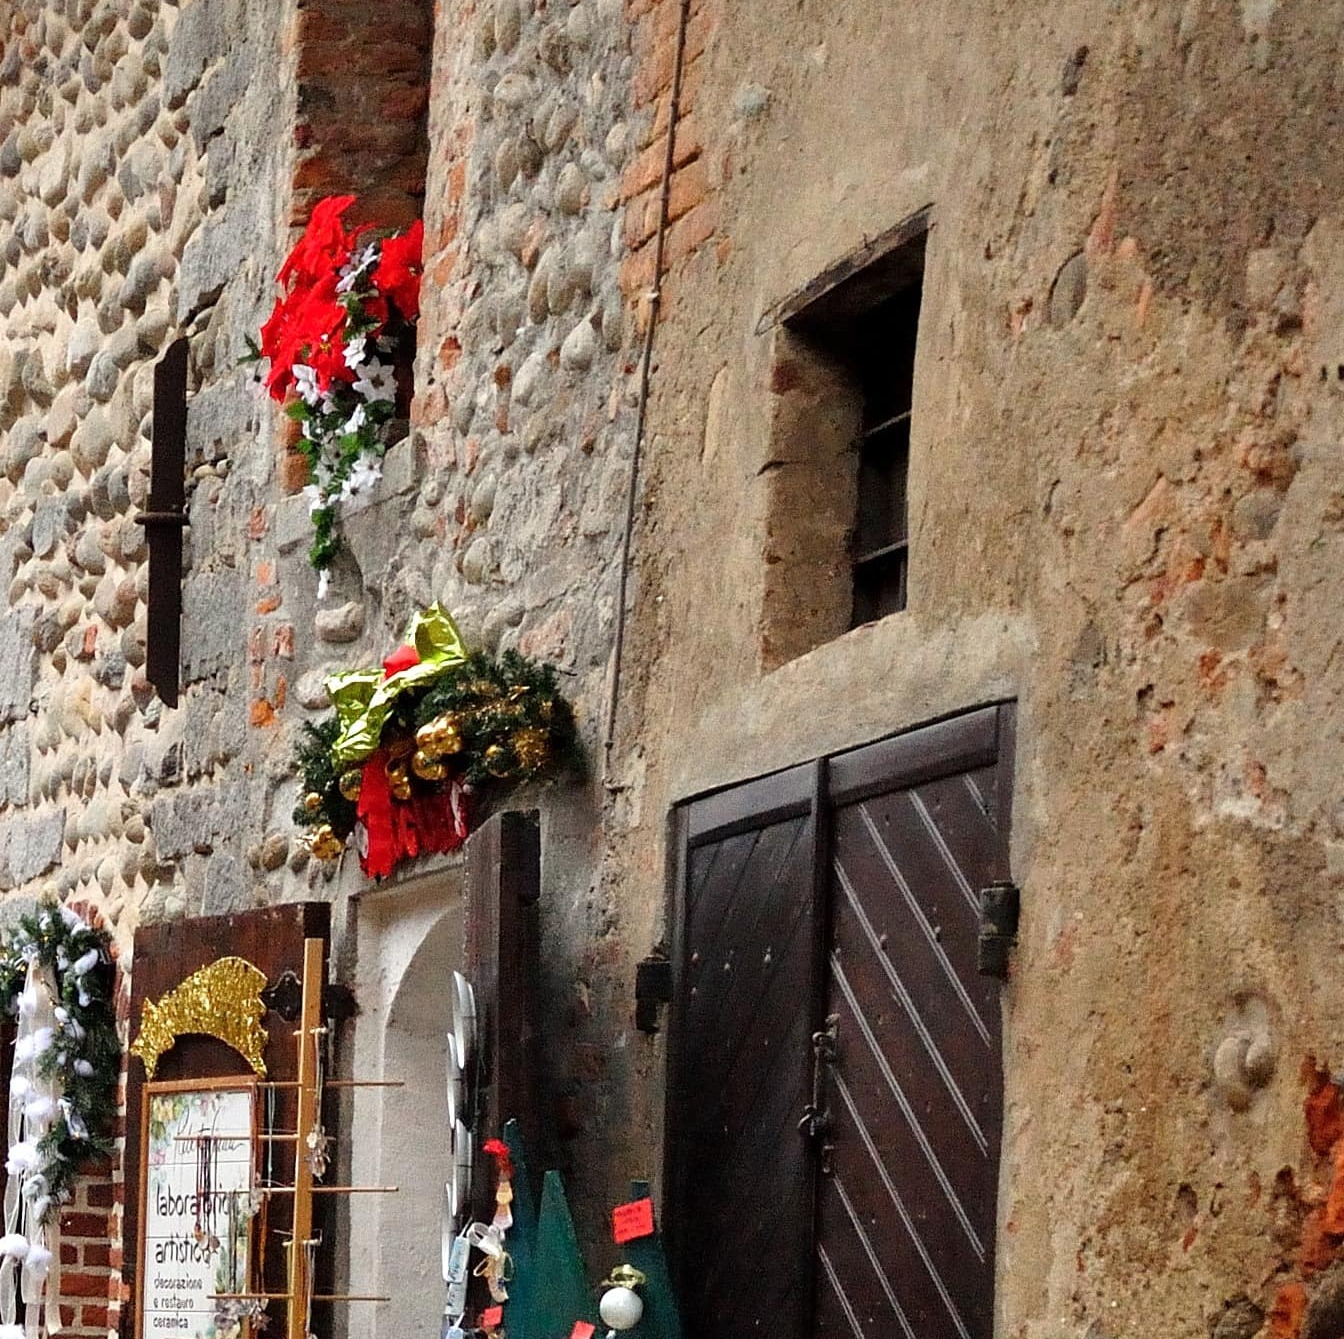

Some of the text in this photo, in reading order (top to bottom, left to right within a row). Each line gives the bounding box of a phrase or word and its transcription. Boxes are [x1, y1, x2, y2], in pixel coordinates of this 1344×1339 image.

[153, 1271, 203, 1289] decorazione
[153, 1293, 194, 1309] e restauro
[153, 1312, 189, 1329] ceramica
